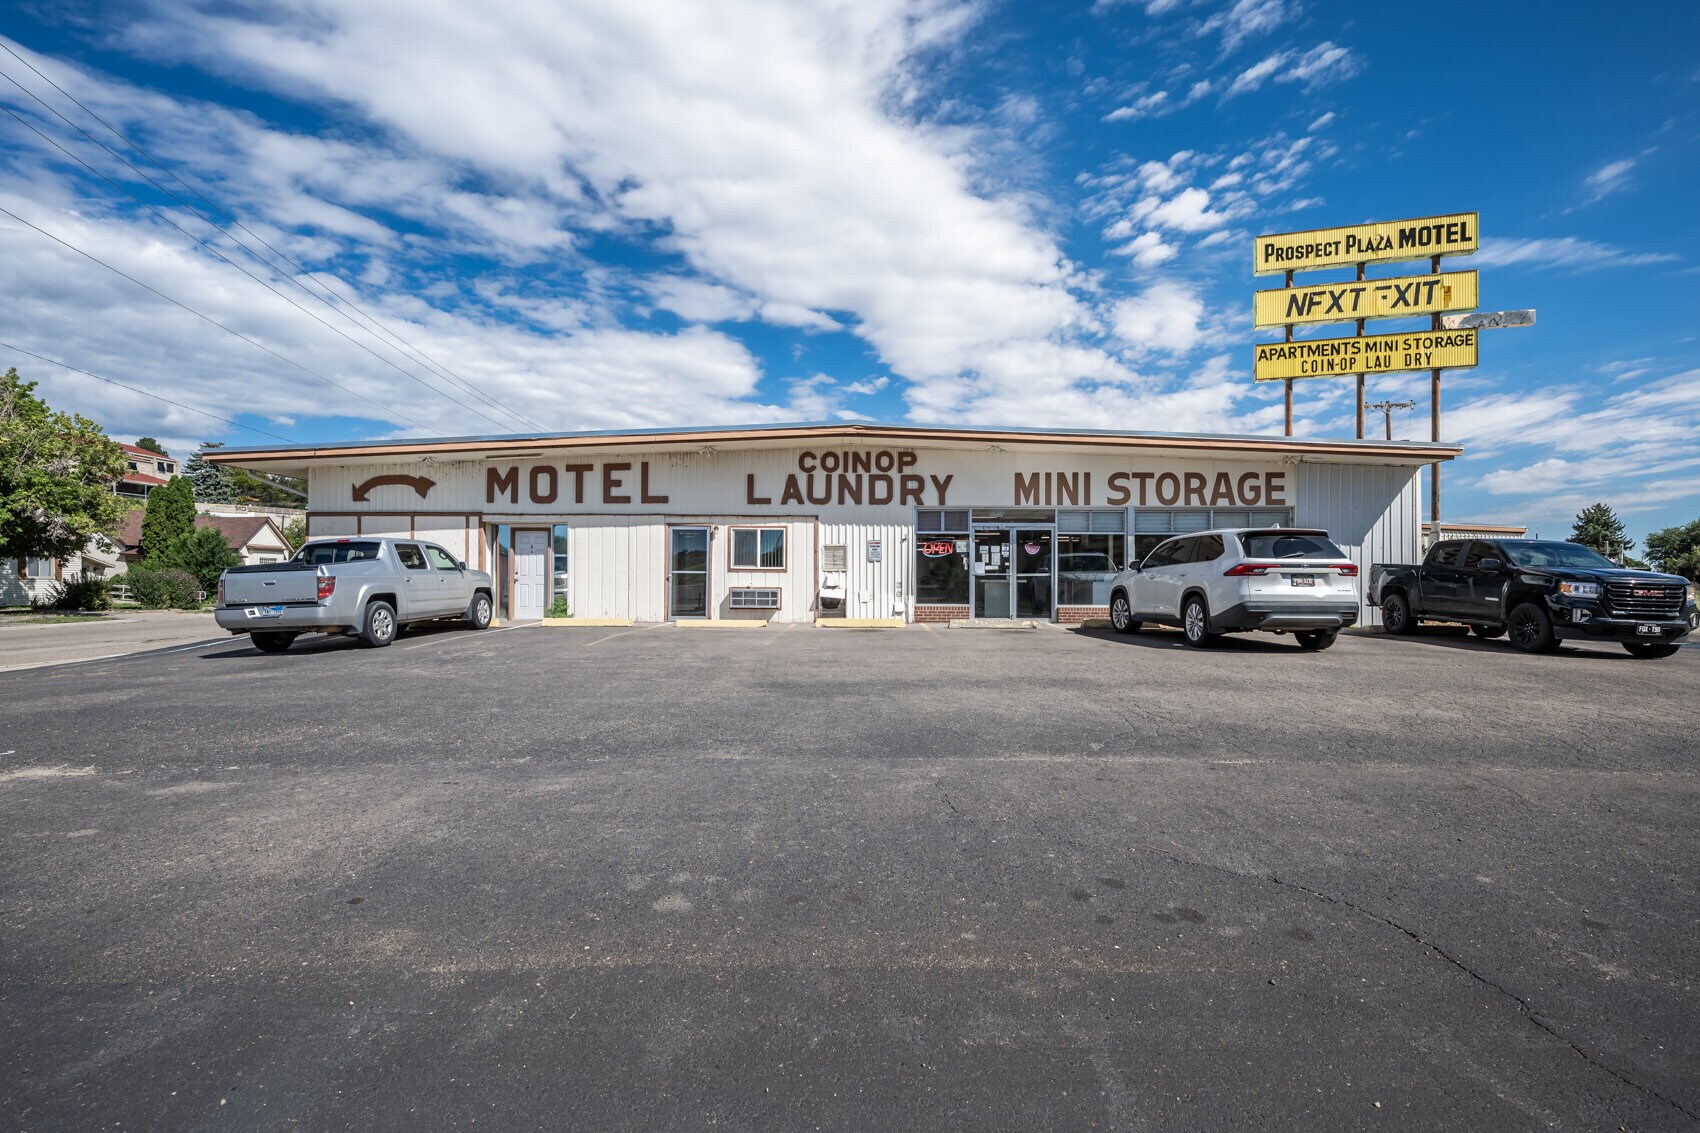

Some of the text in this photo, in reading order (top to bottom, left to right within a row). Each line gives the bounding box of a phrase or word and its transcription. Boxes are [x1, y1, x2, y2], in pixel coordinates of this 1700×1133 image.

[1399, 222, 1473, 249] MOTEL
[1258, 333, 1475, 362] APARTMENTS MINI STORAGE
[1301, 357, 1357, 374] COIN-OP
[798, 450, 917, 474] COINOP
[486, 462, 669, 504] MOTEL
[747, 473, 954, 506] LAUNDRY
[1014, 472, 1286, 506] MINI STORAGE
[923, 541, 954, 556] OPEN
